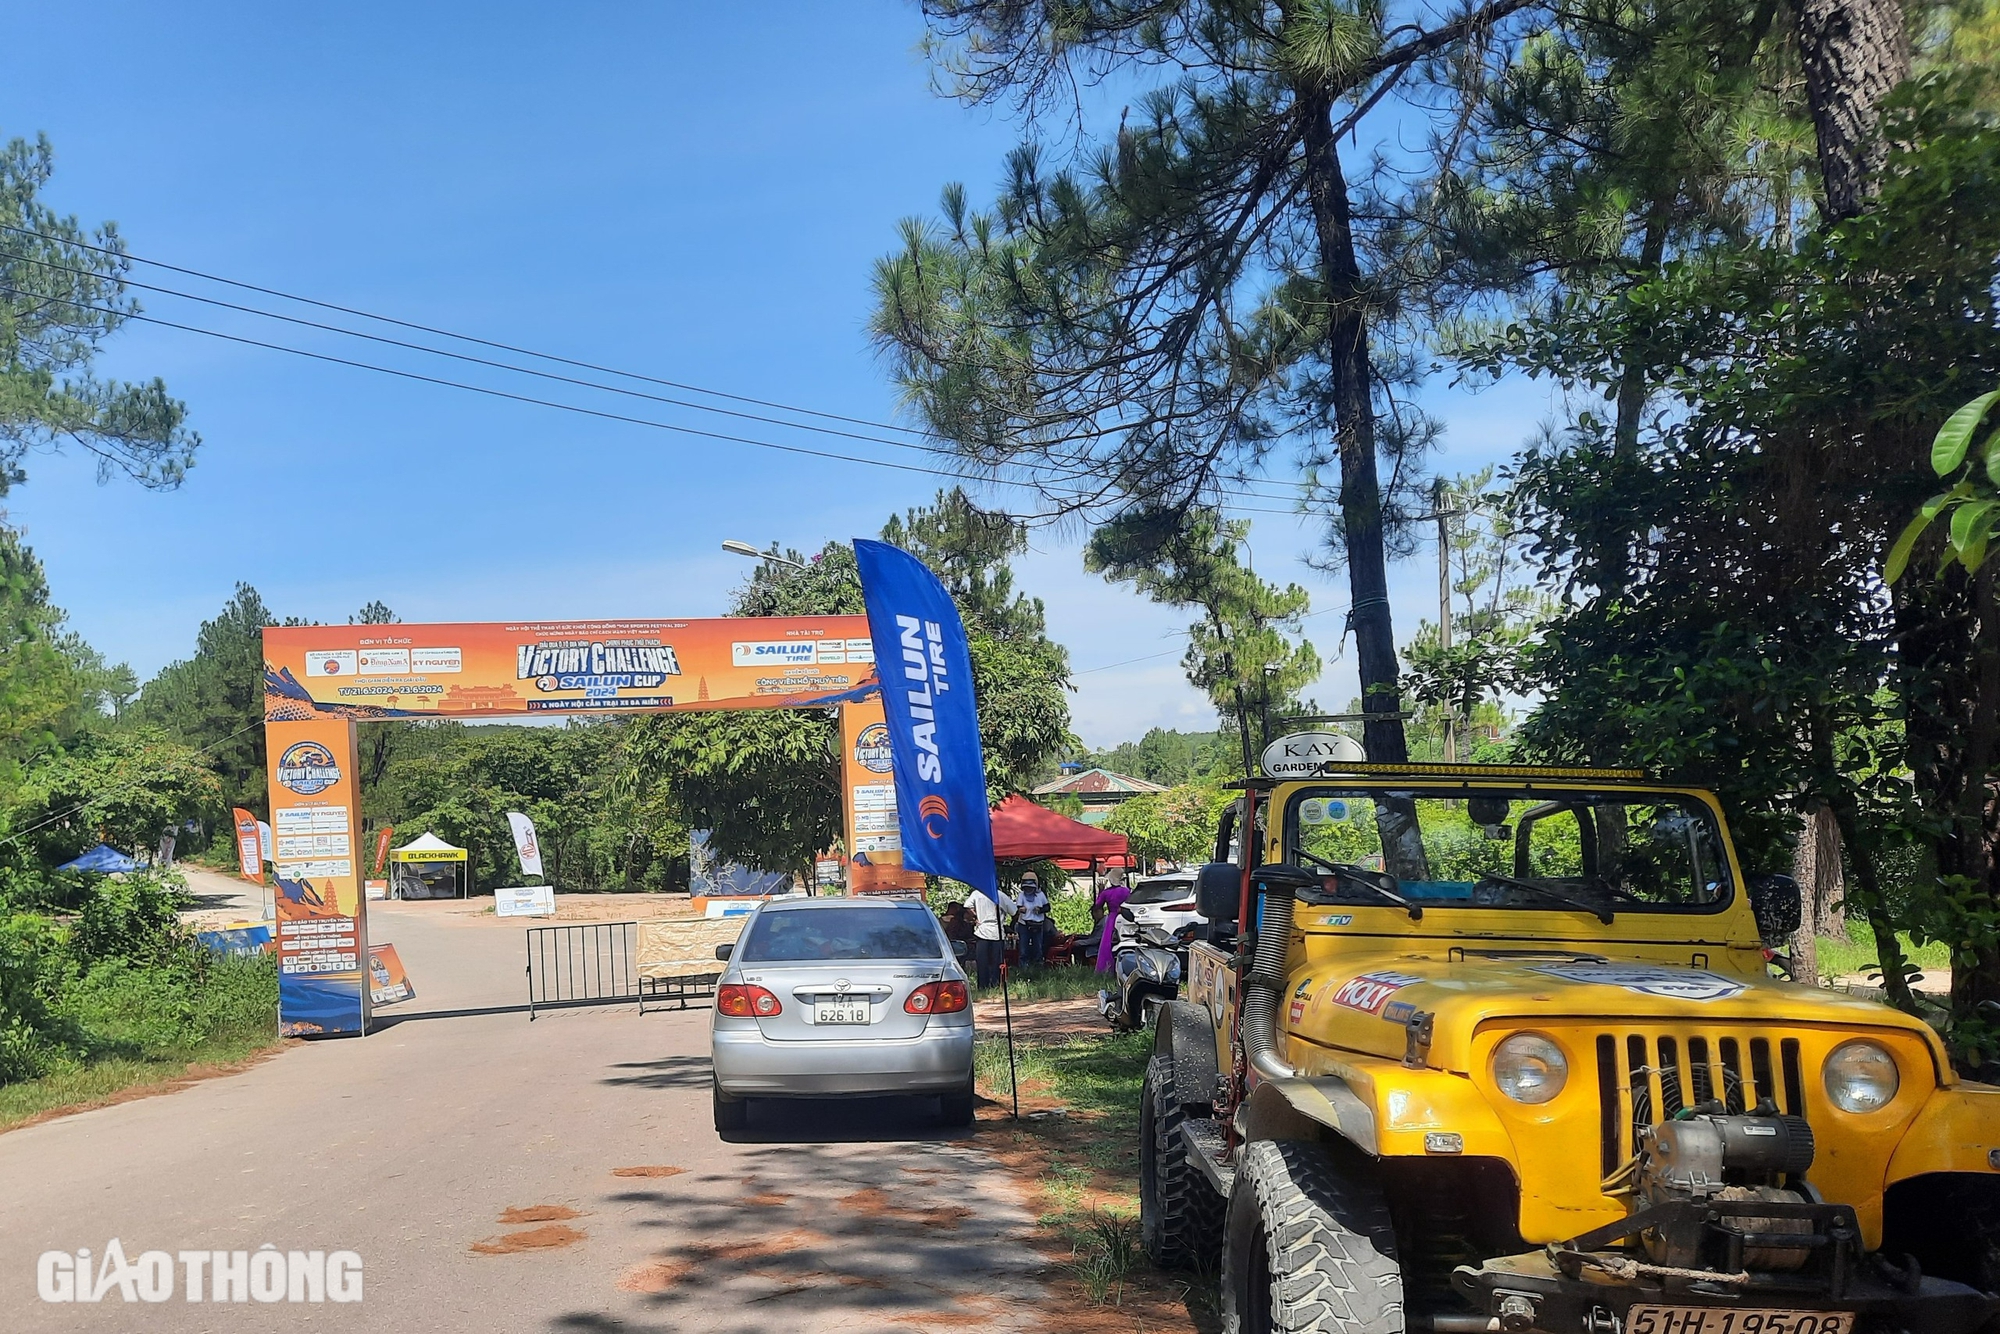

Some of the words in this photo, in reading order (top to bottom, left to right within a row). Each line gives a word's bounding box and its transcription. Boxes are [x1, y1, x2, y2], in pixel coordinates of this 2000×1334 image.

[755, 645, 813, 655] SAILUN
[591, 643, 681, 675] CHALLENGE
[925, 620, 950, 697] TIRE
[561, 675, 630, 688] SAILUN
[633, 675, 661, 687] CUP
[755, 677, 778, 686] CÔNG
[778, 676, 797, 685] VIÊN
[831, 675, 848, 684] TIÊN
[352, 687, 393, 695] 21.6.2024
[400, 686, 443, 694] 23.6.2024
[585, 687, 617, 698] 2024
[896, 614, 942, 784] SAILUN
[1283, 742, 1340, 757] KAY
[408, 852, 459, 860] BLACKHAWK
[1316, 914, 1353, 925] HTV
[1335, 979, 1396, 1011] MOLY
[820, 1009, 864, 1021] 626.18
